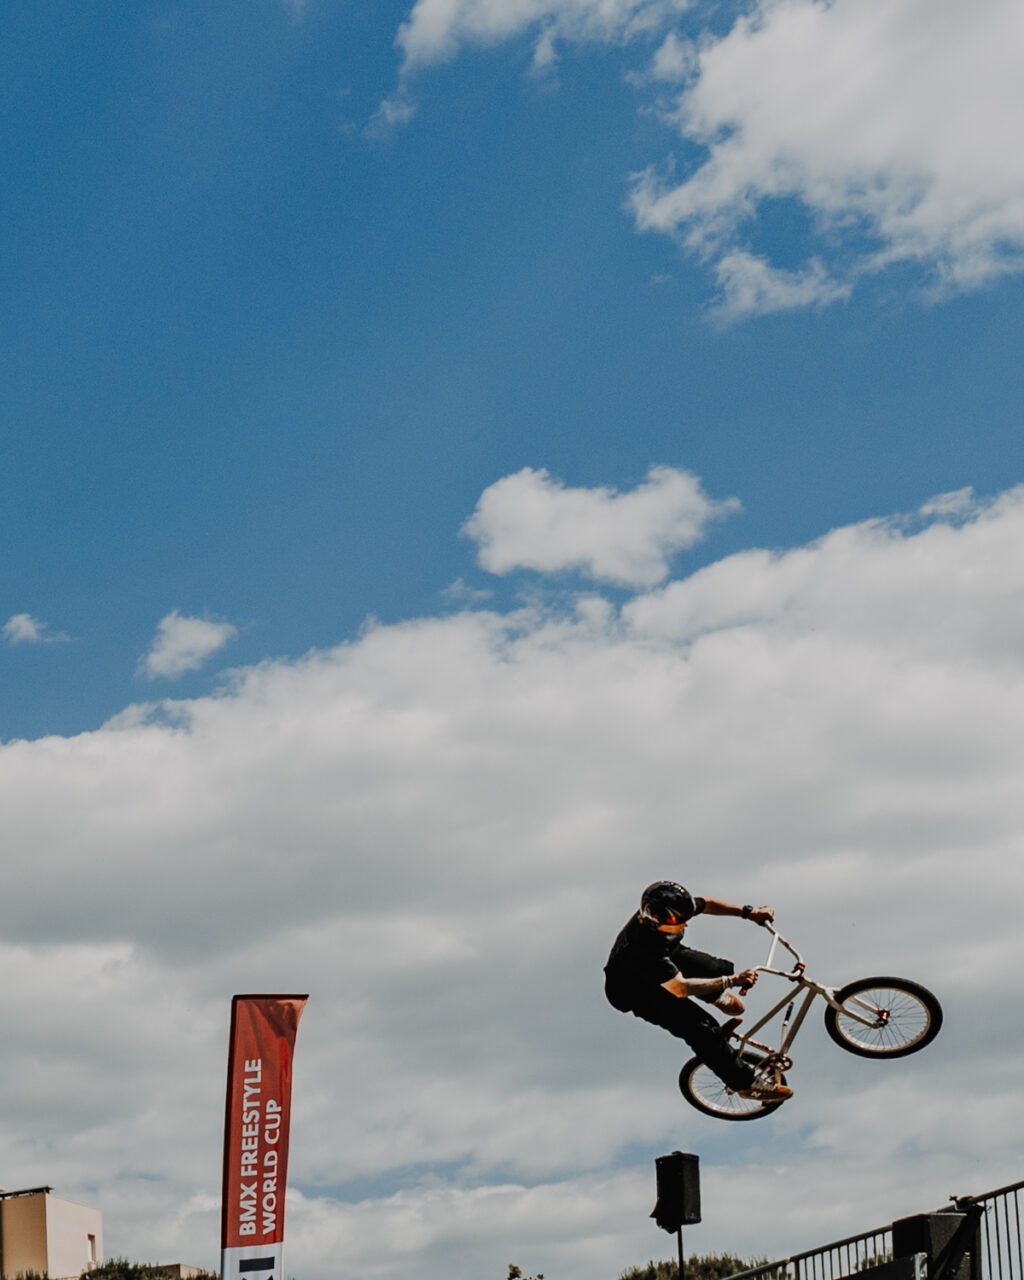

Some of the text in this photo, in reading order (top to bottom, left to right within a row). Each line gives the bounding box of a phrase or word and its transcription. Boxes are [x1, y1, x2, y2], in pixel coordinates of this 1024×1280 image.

[239, 1058, 262, 1236] BMX FREESTYLE
[262, 1099, 282, 1235] WORLD CUP
